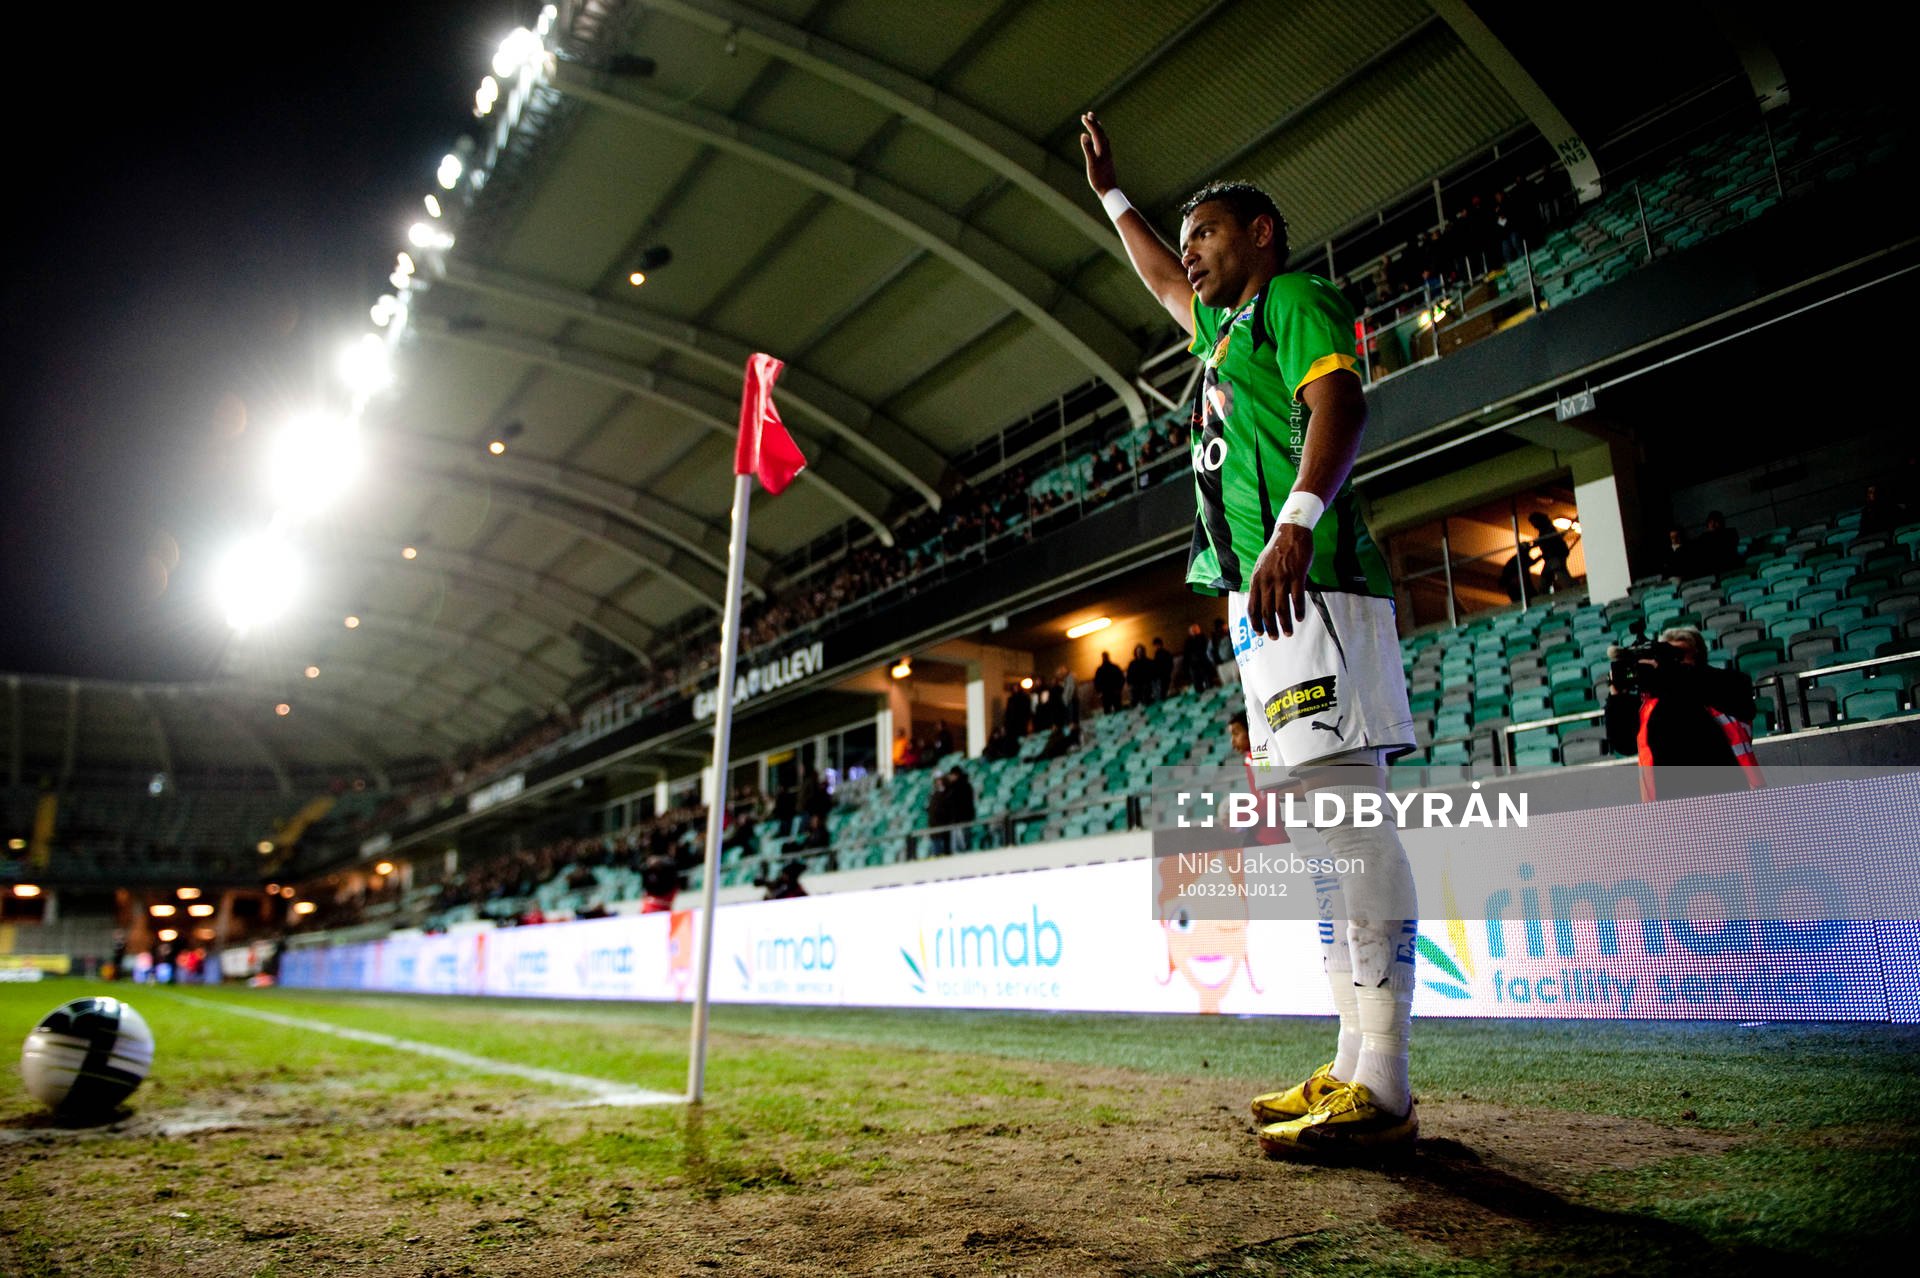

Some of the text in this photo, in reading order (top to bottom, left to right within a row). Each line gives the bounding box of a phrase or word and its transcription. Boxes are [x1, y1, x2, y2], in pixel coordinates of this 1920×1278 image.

[761, 640, 824, 693] ULLEVI
[1265, 684, 1326, 725] gardera
[1485, 839, 1848, 959] rimab
[936, 903, 1063, 968] rimab
[1493, 964, 1846, 1013] facility service
